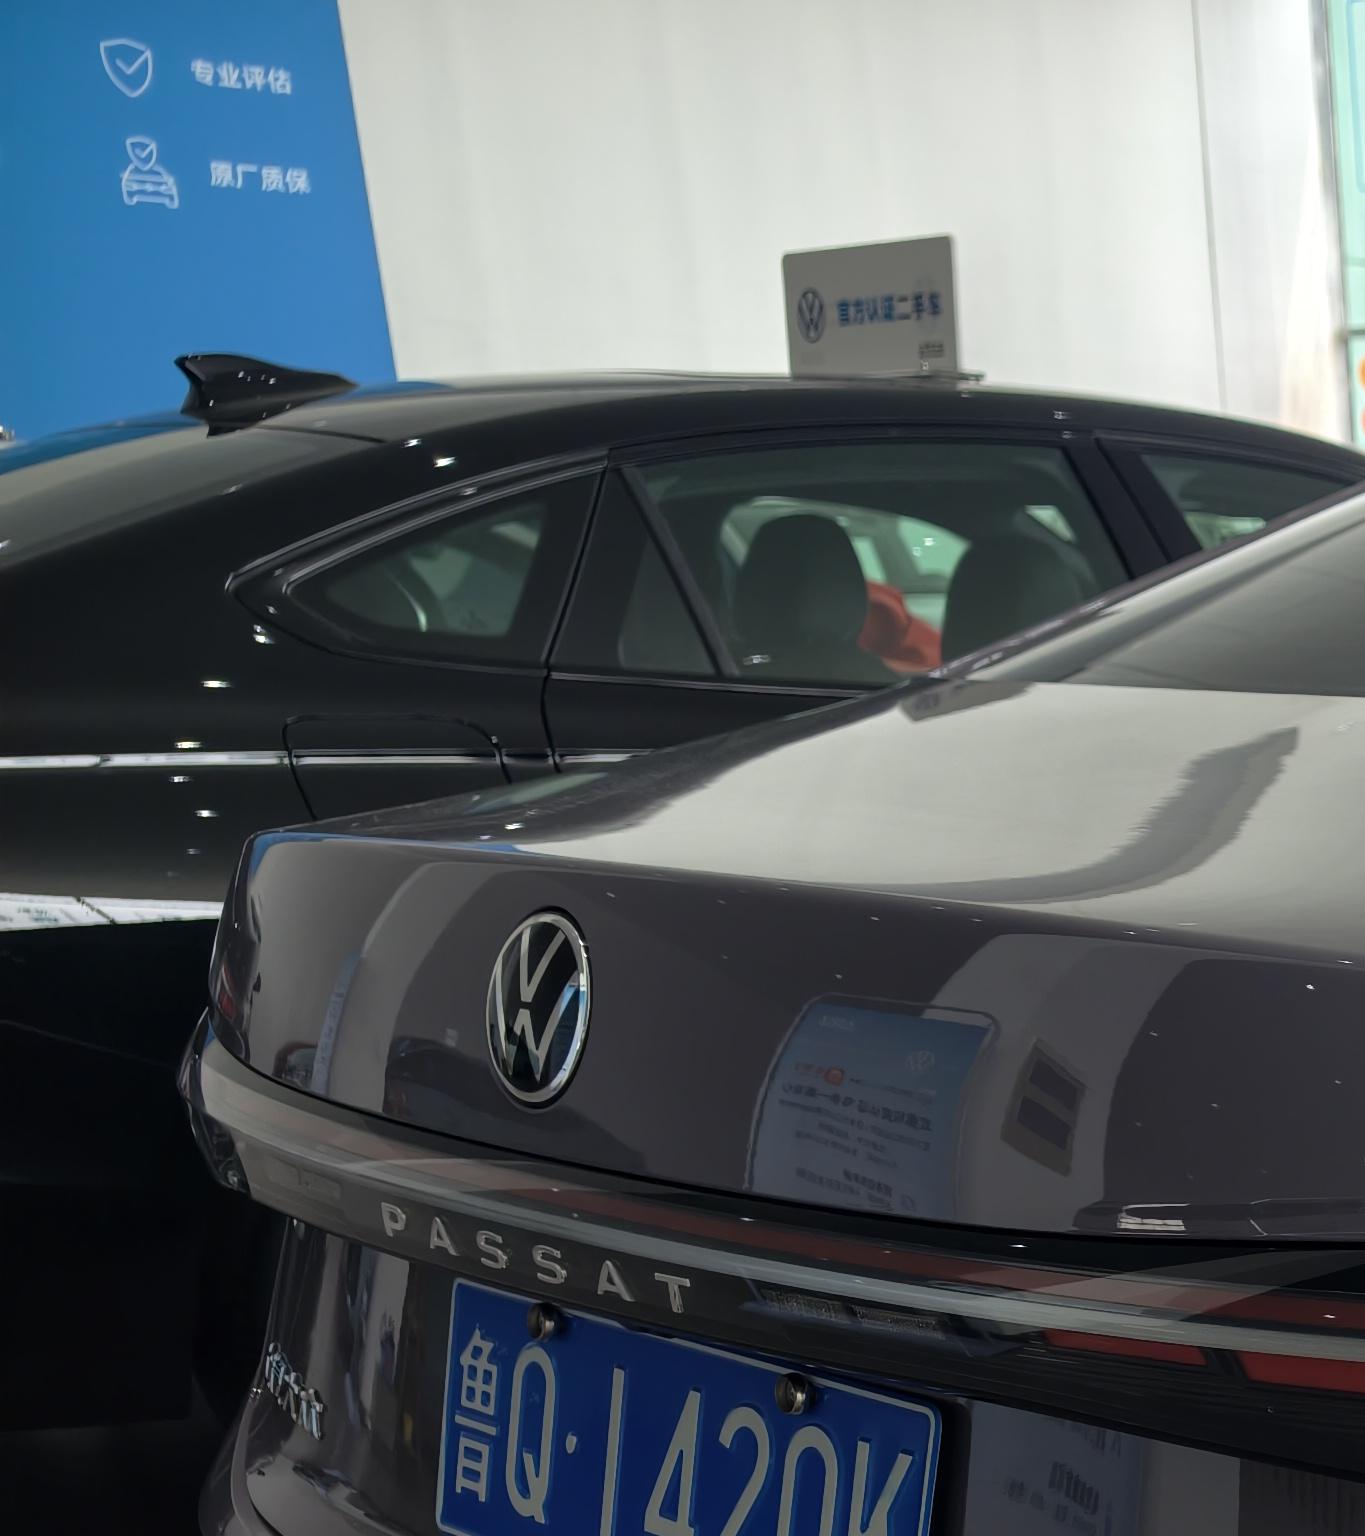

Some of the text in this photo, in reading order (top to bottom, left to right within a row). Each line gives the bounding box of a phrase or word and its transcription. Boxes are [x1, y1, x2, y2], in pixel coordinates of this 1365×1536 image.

[191, 58, 292, 95] 专业评估
[210, 160, 311, 194] 原厂质保
[380, 1202, 691, 1315] PASSAT
